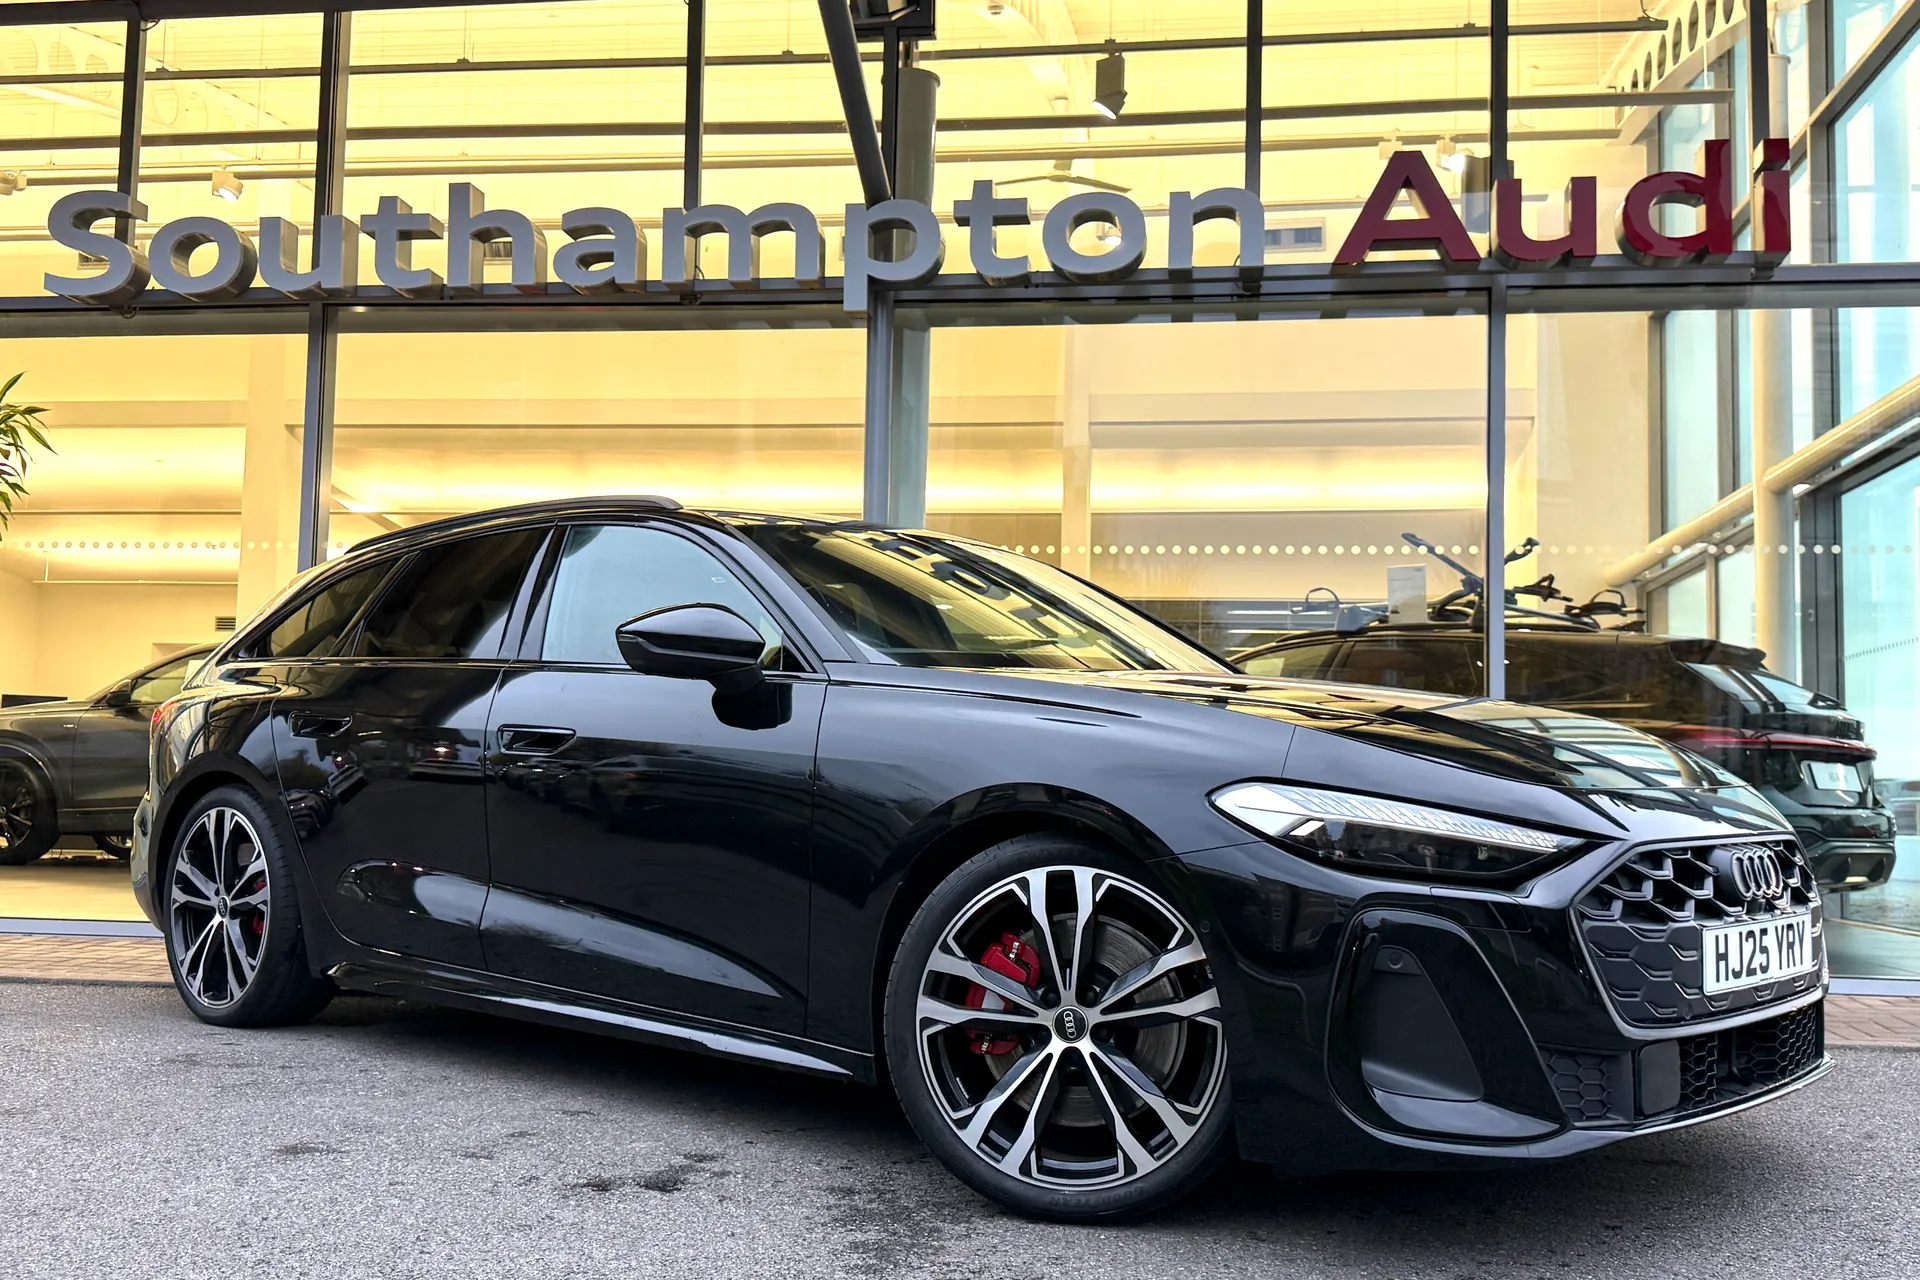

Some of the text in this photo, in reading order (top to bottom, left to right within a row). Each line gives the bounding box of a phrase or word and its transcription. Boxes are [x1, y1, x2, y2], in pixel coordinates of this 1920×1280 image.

[44, 138, 1791, 315] Southampton Audi
[1715, 920, 1805, 983] HJ25 YRY
